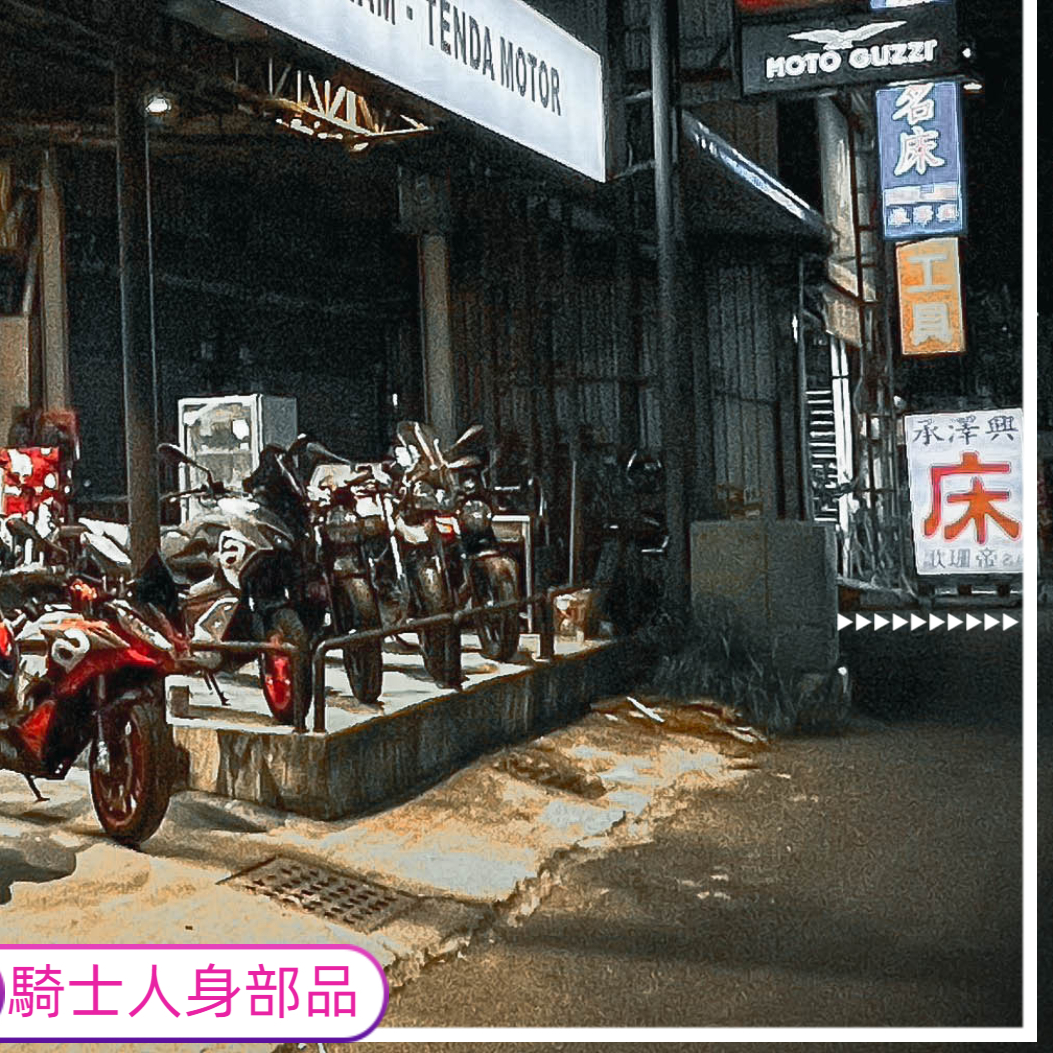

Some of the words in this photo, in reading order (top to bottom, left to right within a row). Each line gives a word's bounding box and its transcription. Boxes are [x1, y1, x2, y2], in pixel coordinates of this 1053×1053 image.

[500, 35, 562, 116] MOTOR
[765, 50, 842, 79] MOTO
[848, 38, 938, 71] GUZZI
[912, 413, 1019, 446] 承澤興
[923, 450, 1023, 545] 床
